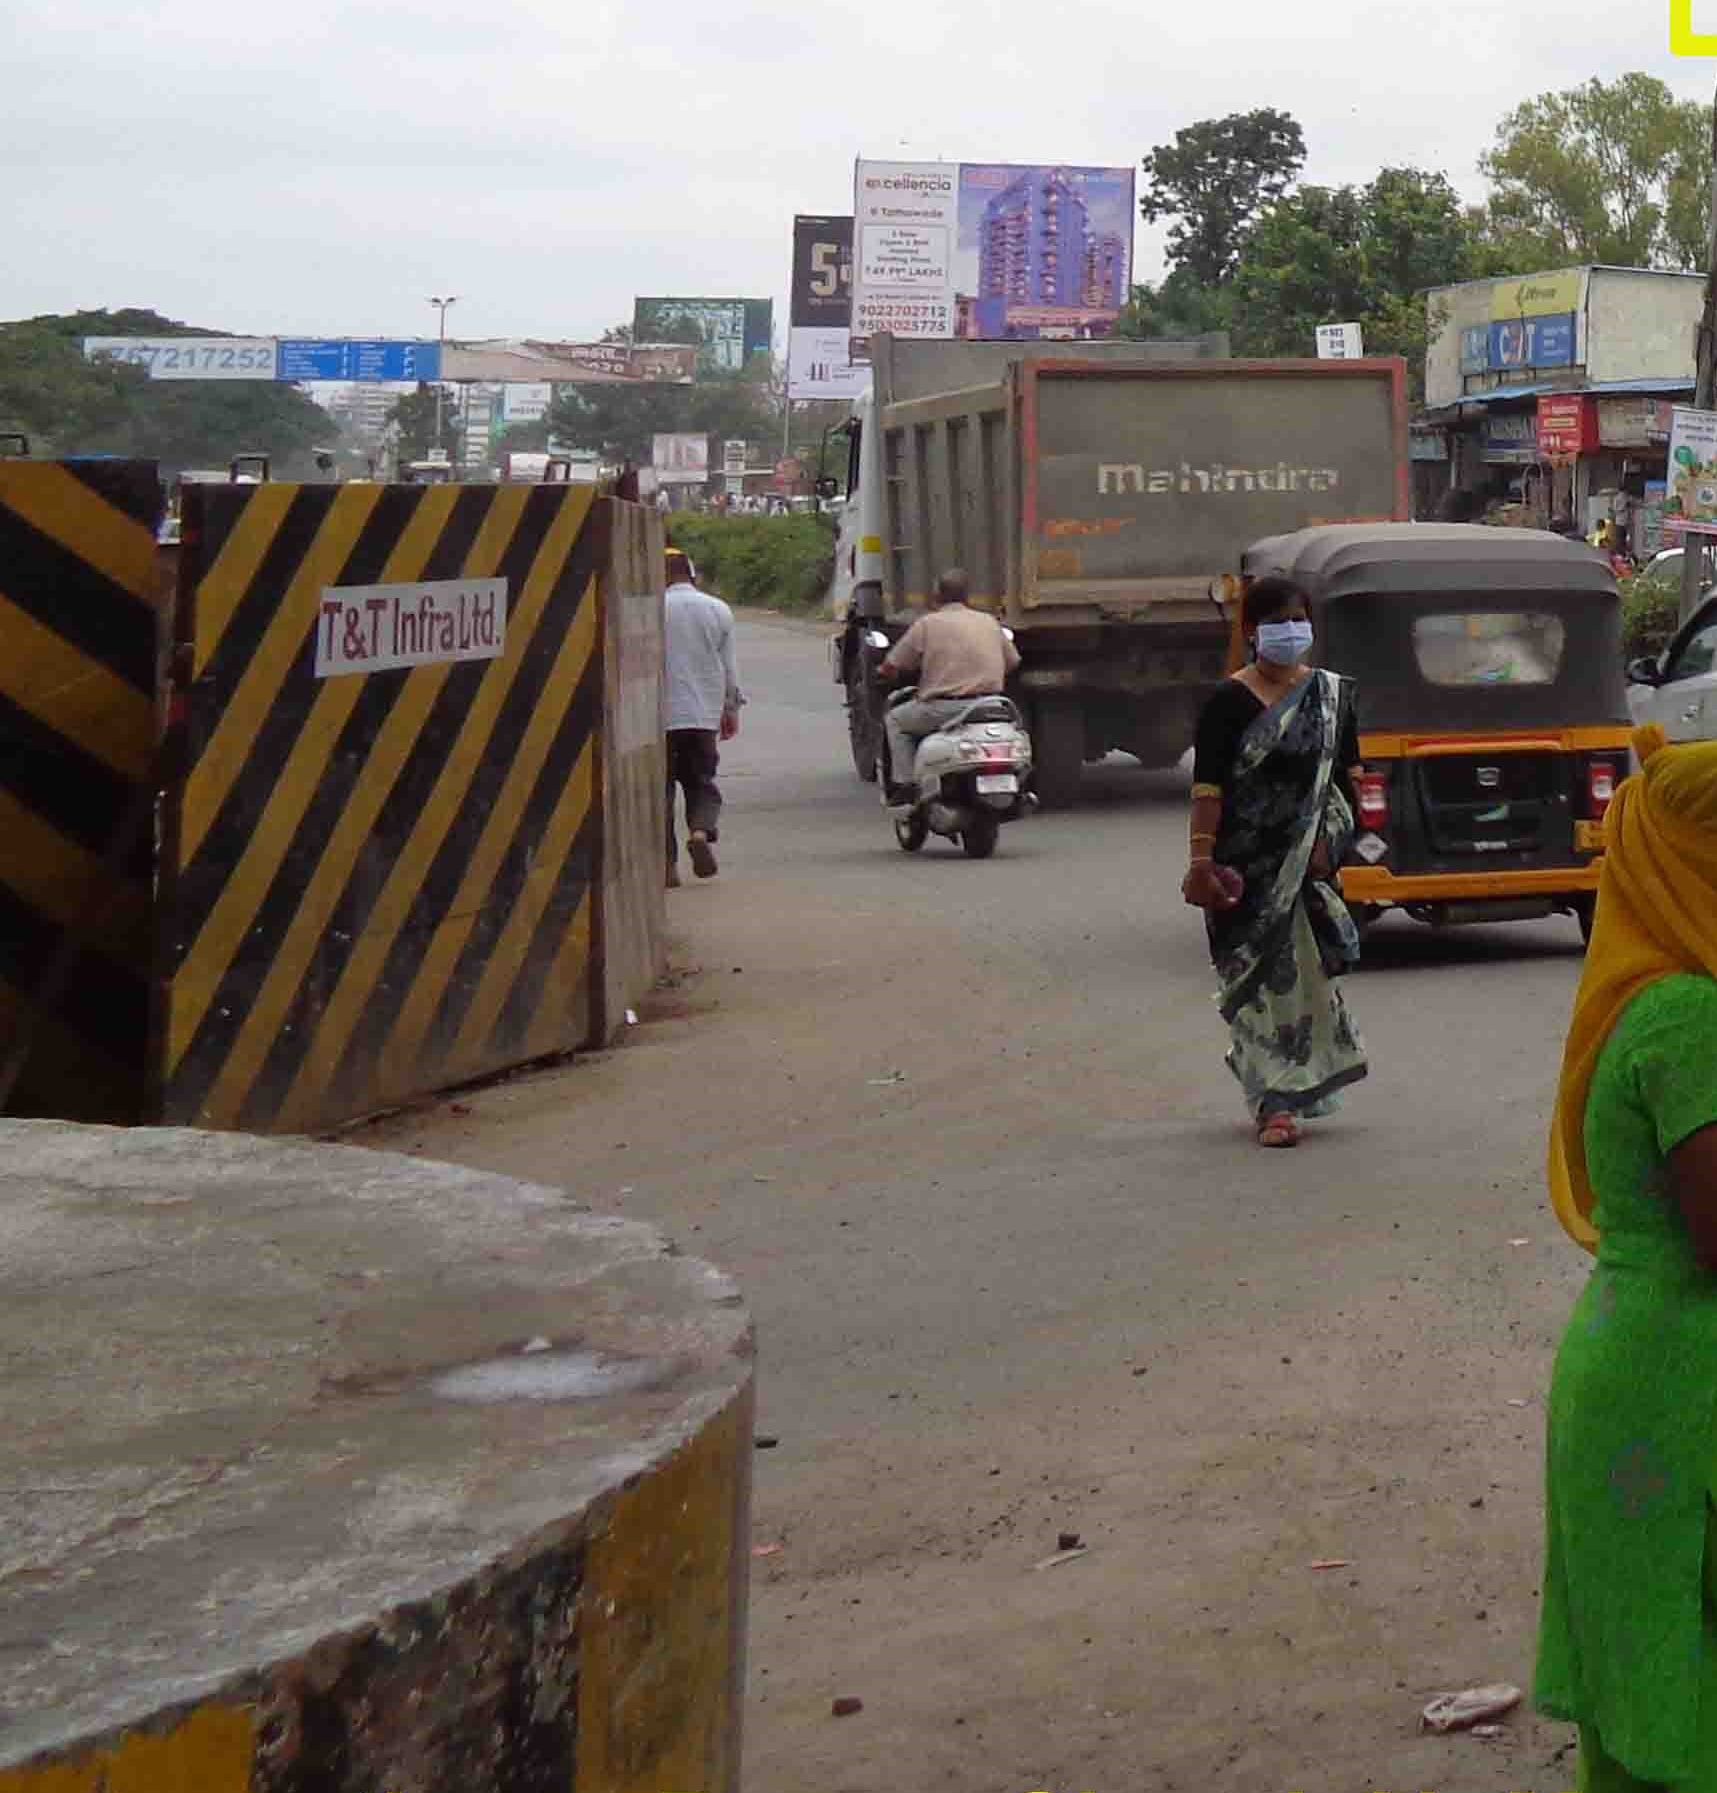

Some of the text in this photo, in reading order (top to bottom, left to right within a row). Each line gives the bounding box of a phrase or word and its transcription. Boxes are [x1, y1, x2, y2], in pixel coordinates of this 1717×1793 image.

[1097, 462, 1340, 495] Mahindra
[322, 590, 501, 661] T&T Infra Ltd.
